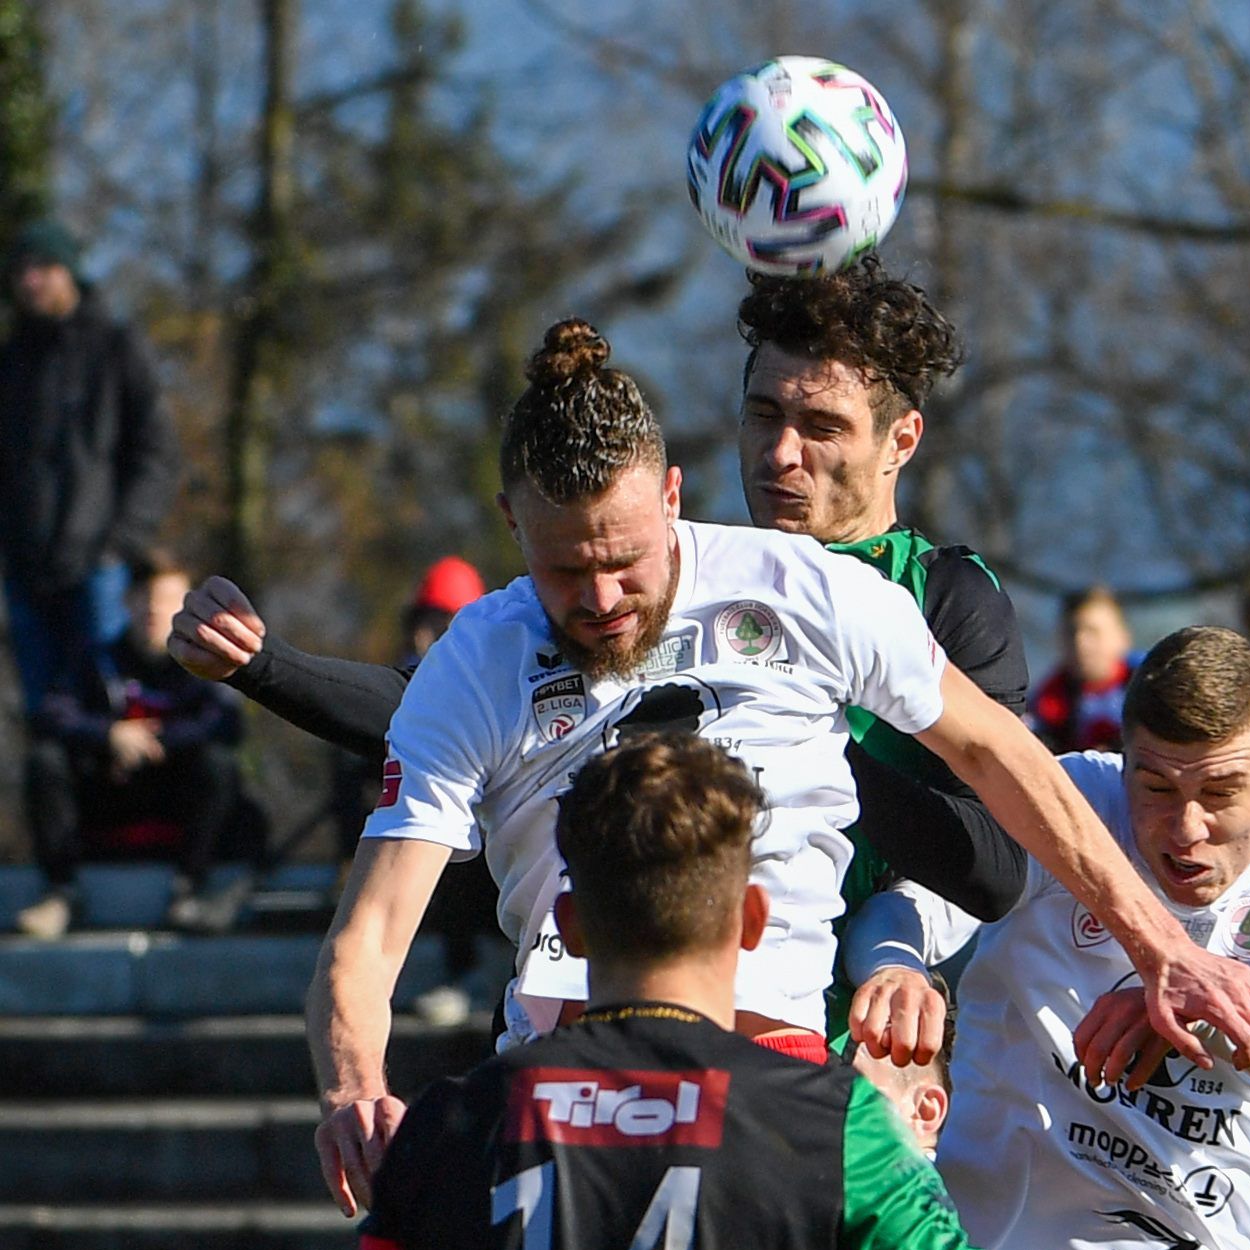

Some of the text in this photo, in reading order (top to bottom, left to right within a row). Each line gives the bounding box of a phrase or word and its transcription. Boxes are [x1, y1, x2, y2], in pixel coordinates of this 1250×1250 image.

[551, 698, 582, 711] LIGA
[1190, 1077, 1223, 1096] 1834
[533, 1080, 700, 1136] Tirol
